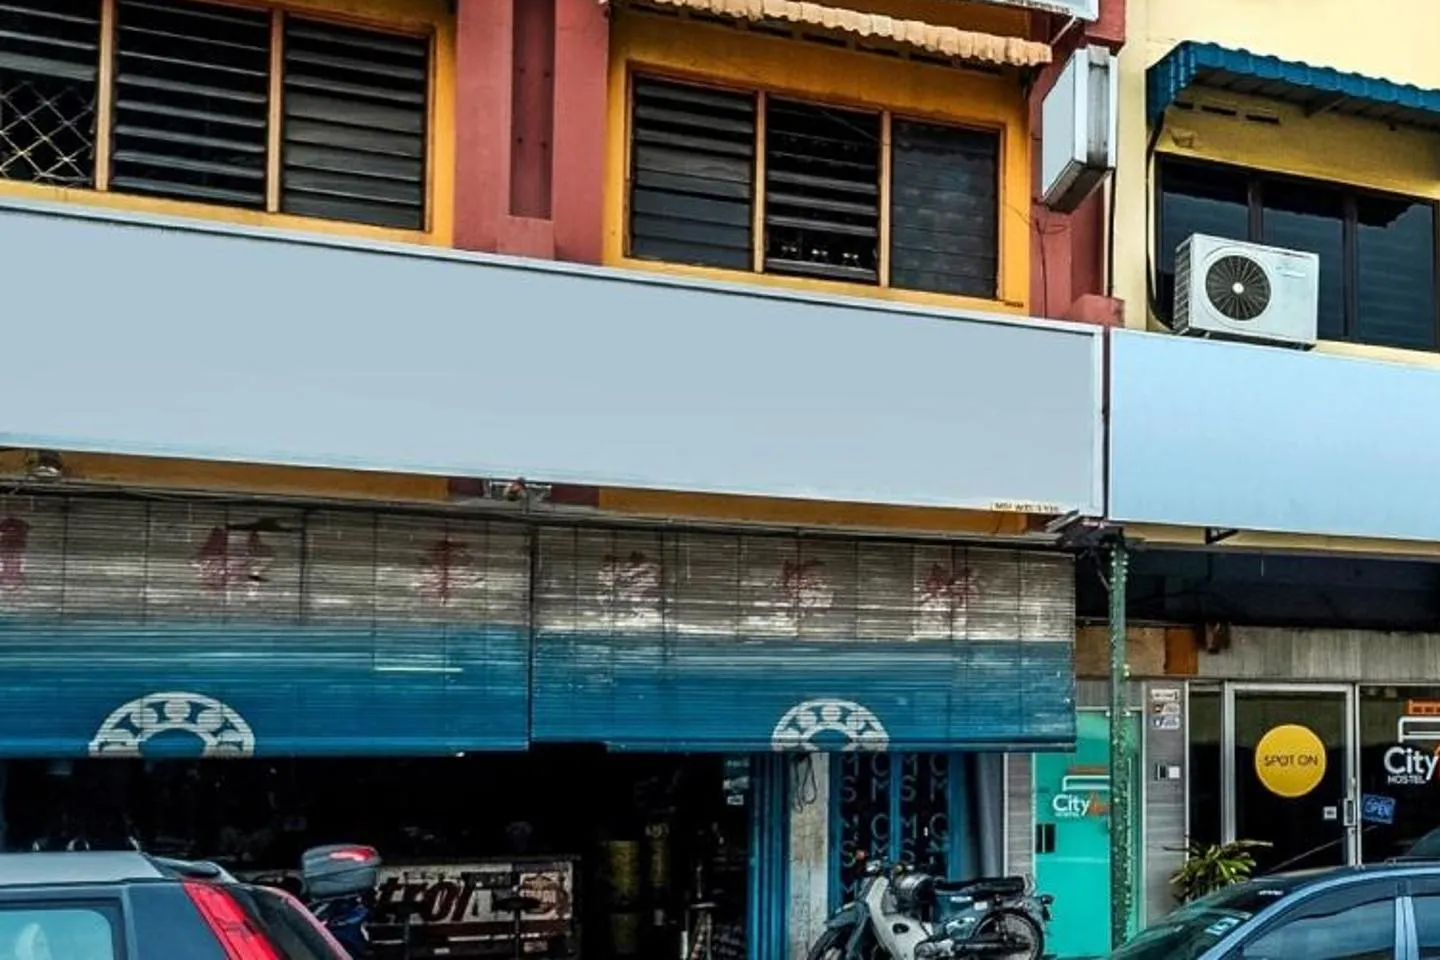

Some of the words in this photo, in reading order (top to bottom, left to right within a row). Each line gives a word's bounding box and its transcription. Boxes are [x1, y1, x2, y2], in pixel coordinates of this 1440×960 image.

[1264, 753, 1295, 767] SPOT
[1297, 753, 1318, 767] ON
[1383, 746, 1440, 781] City
[1053, 793, 1091, 816] City
